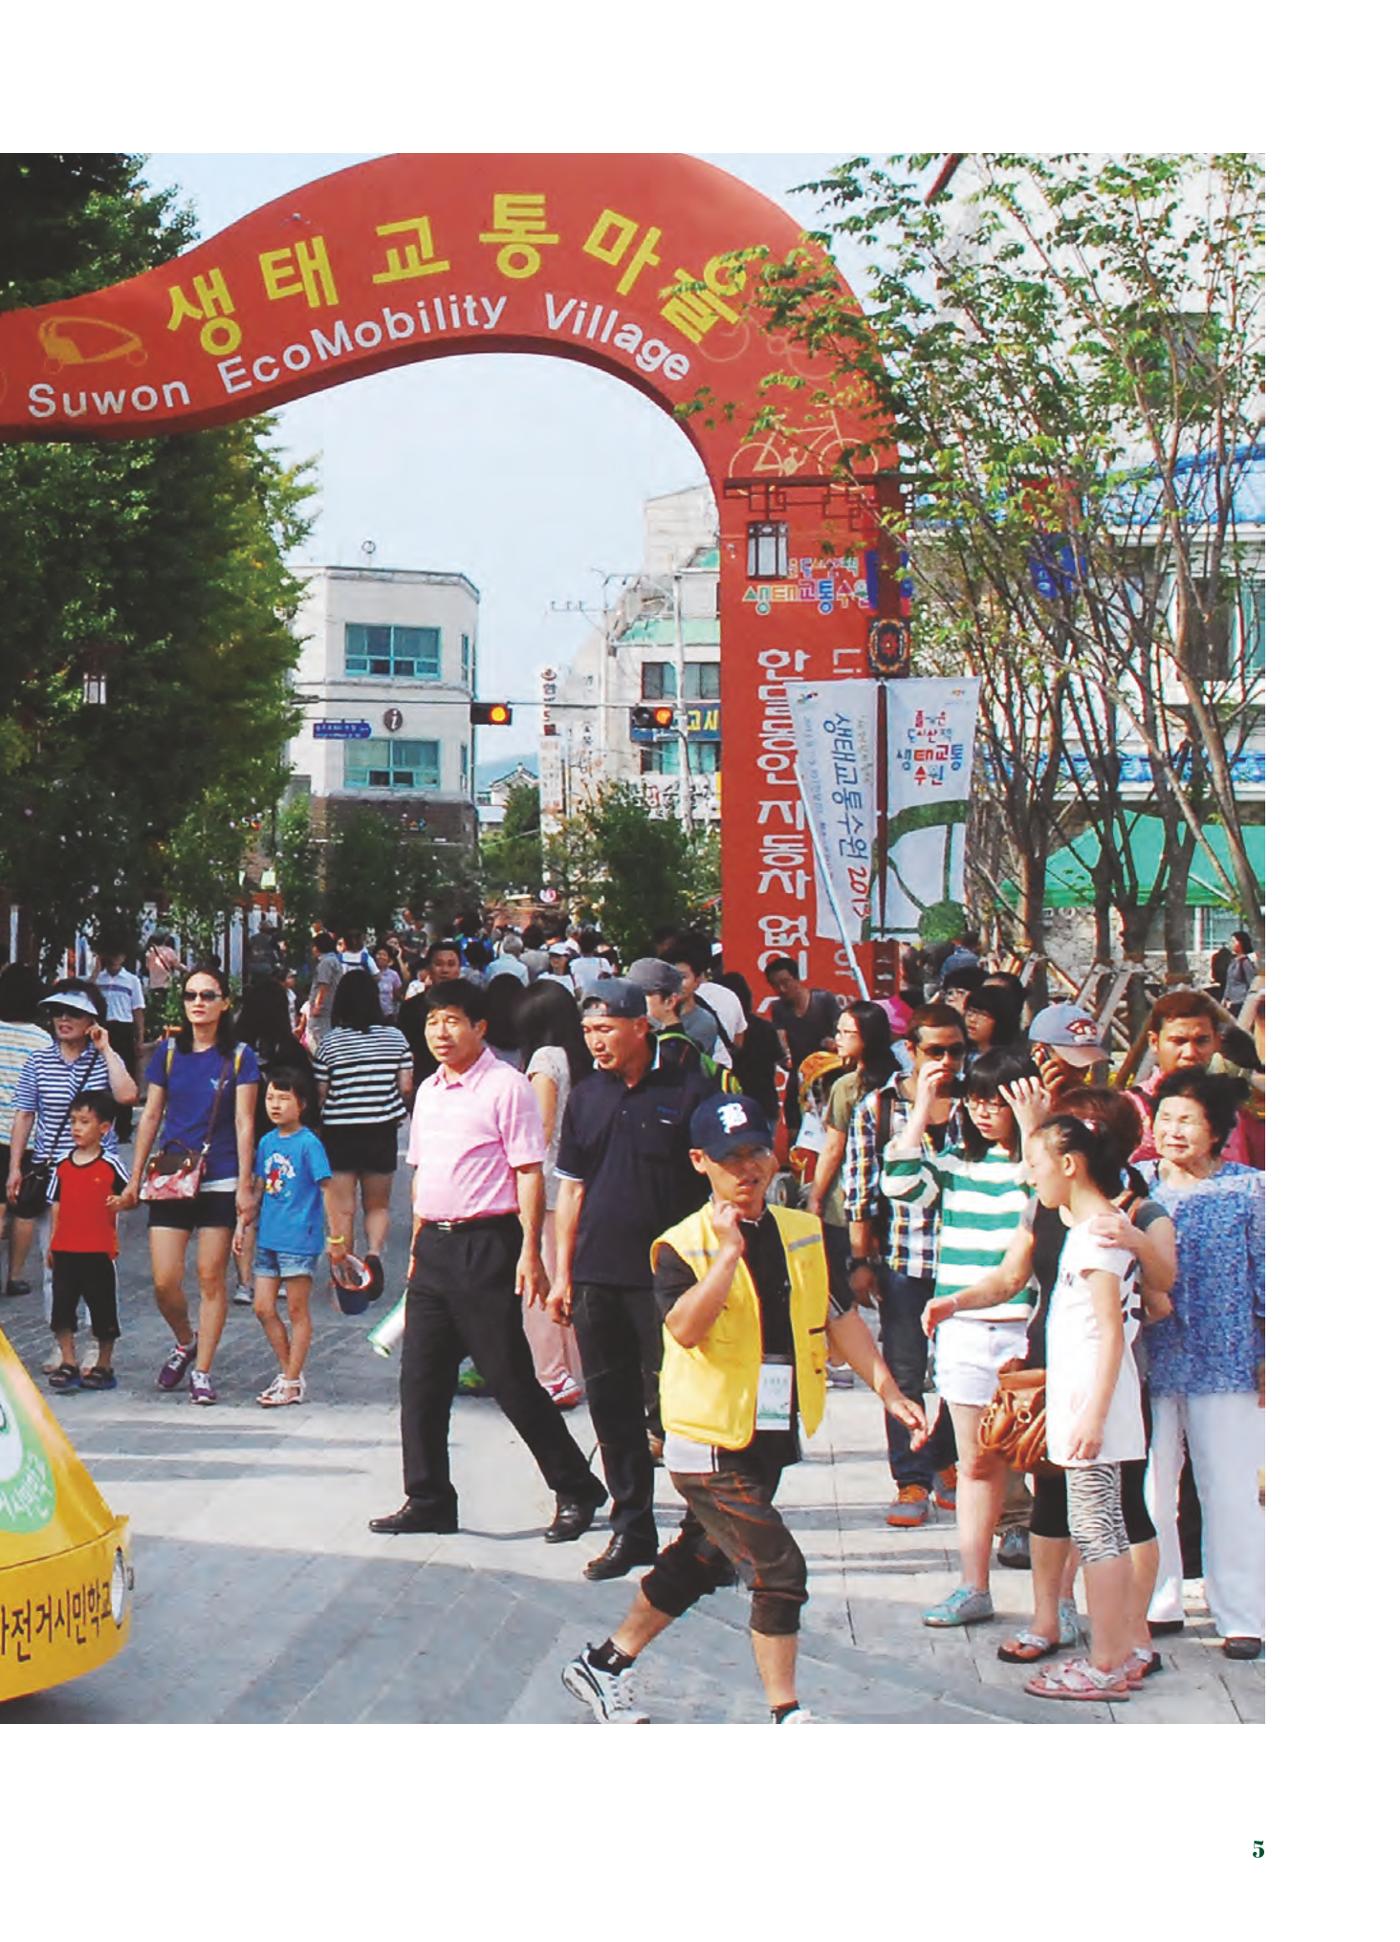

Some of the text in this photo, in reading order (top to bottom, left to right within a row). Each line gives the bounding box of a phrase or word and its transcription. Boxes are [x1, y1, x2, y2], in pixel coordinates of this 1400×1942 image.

[27, 292, 690, 418] Suwon EcoMobility Village
[822, 712, 869, 860] 생태교통수원
[756, 800, 813, 900] 자동차
